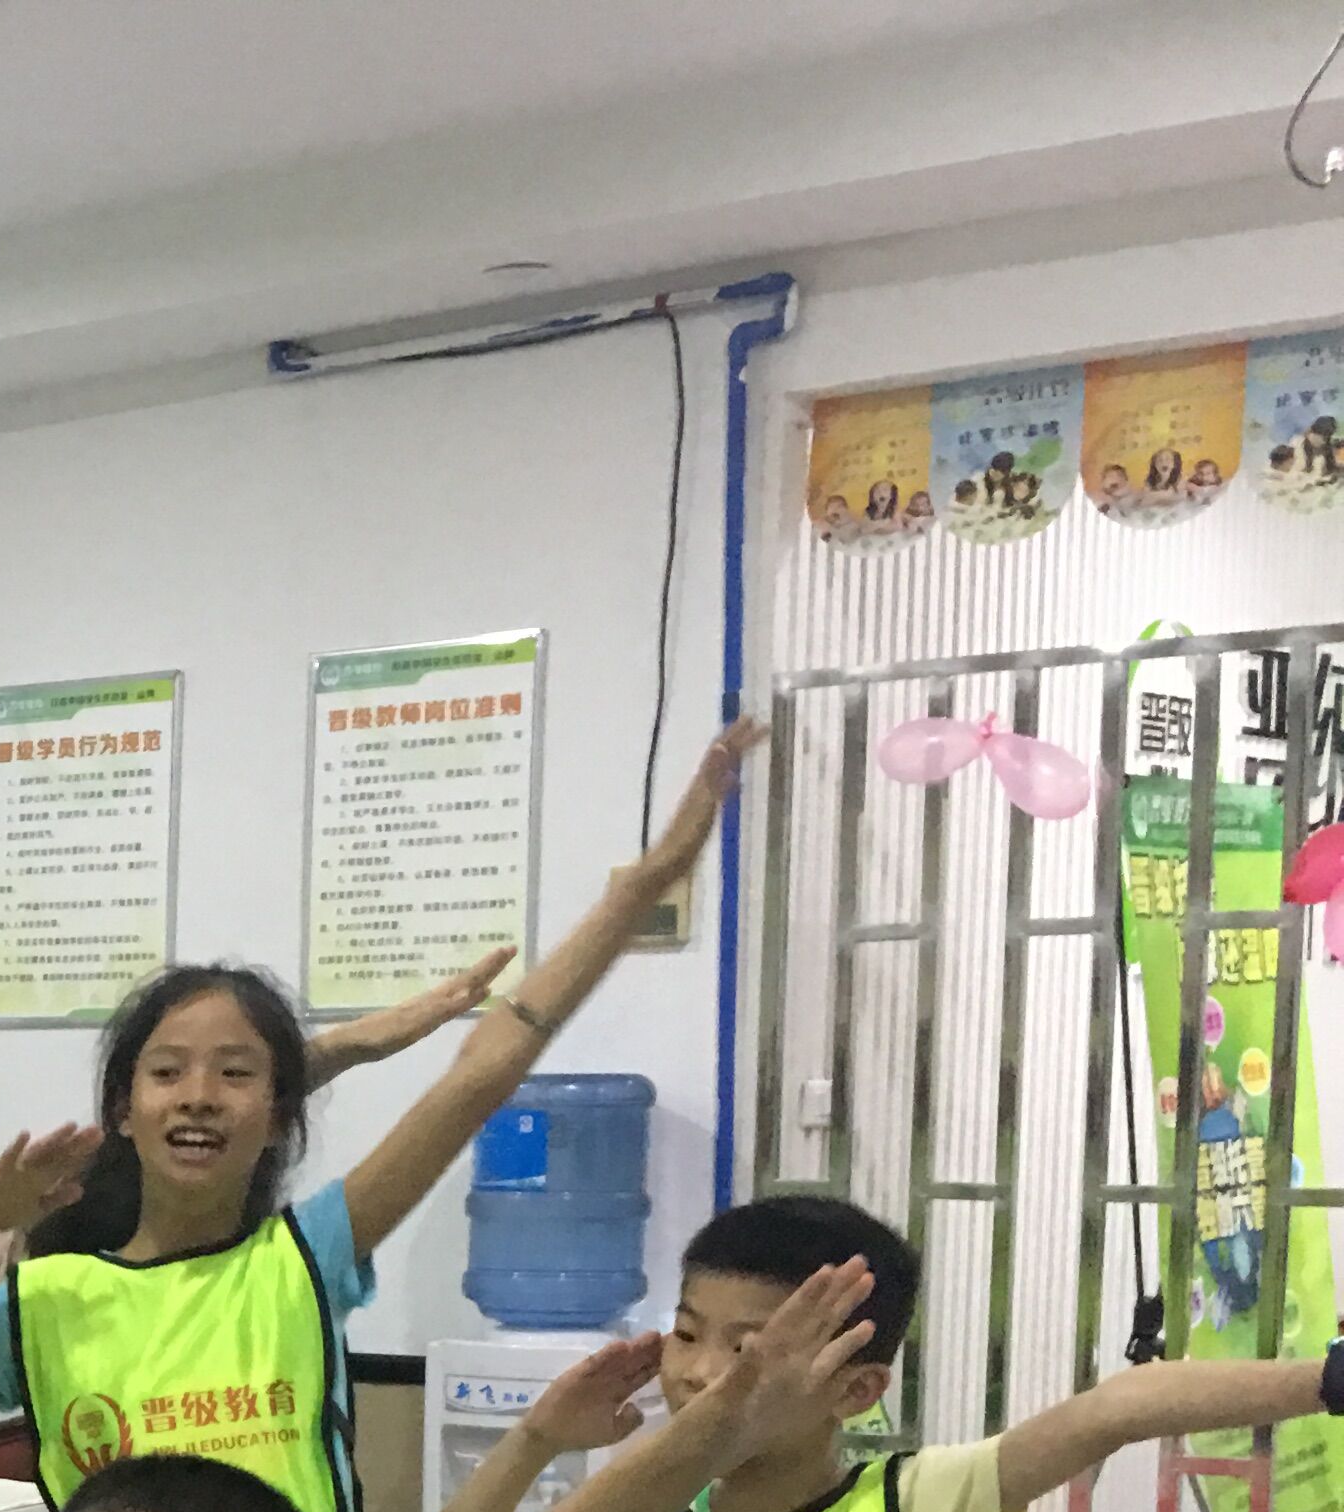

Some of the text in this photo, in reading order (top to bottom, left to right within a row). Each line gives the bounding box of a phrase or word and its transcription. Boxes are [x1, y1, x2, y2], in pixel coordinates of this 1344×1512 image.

[141, 1379, 296, 1433] 晋级教育
[197, 1428, 301, 1454] EDUCATION
